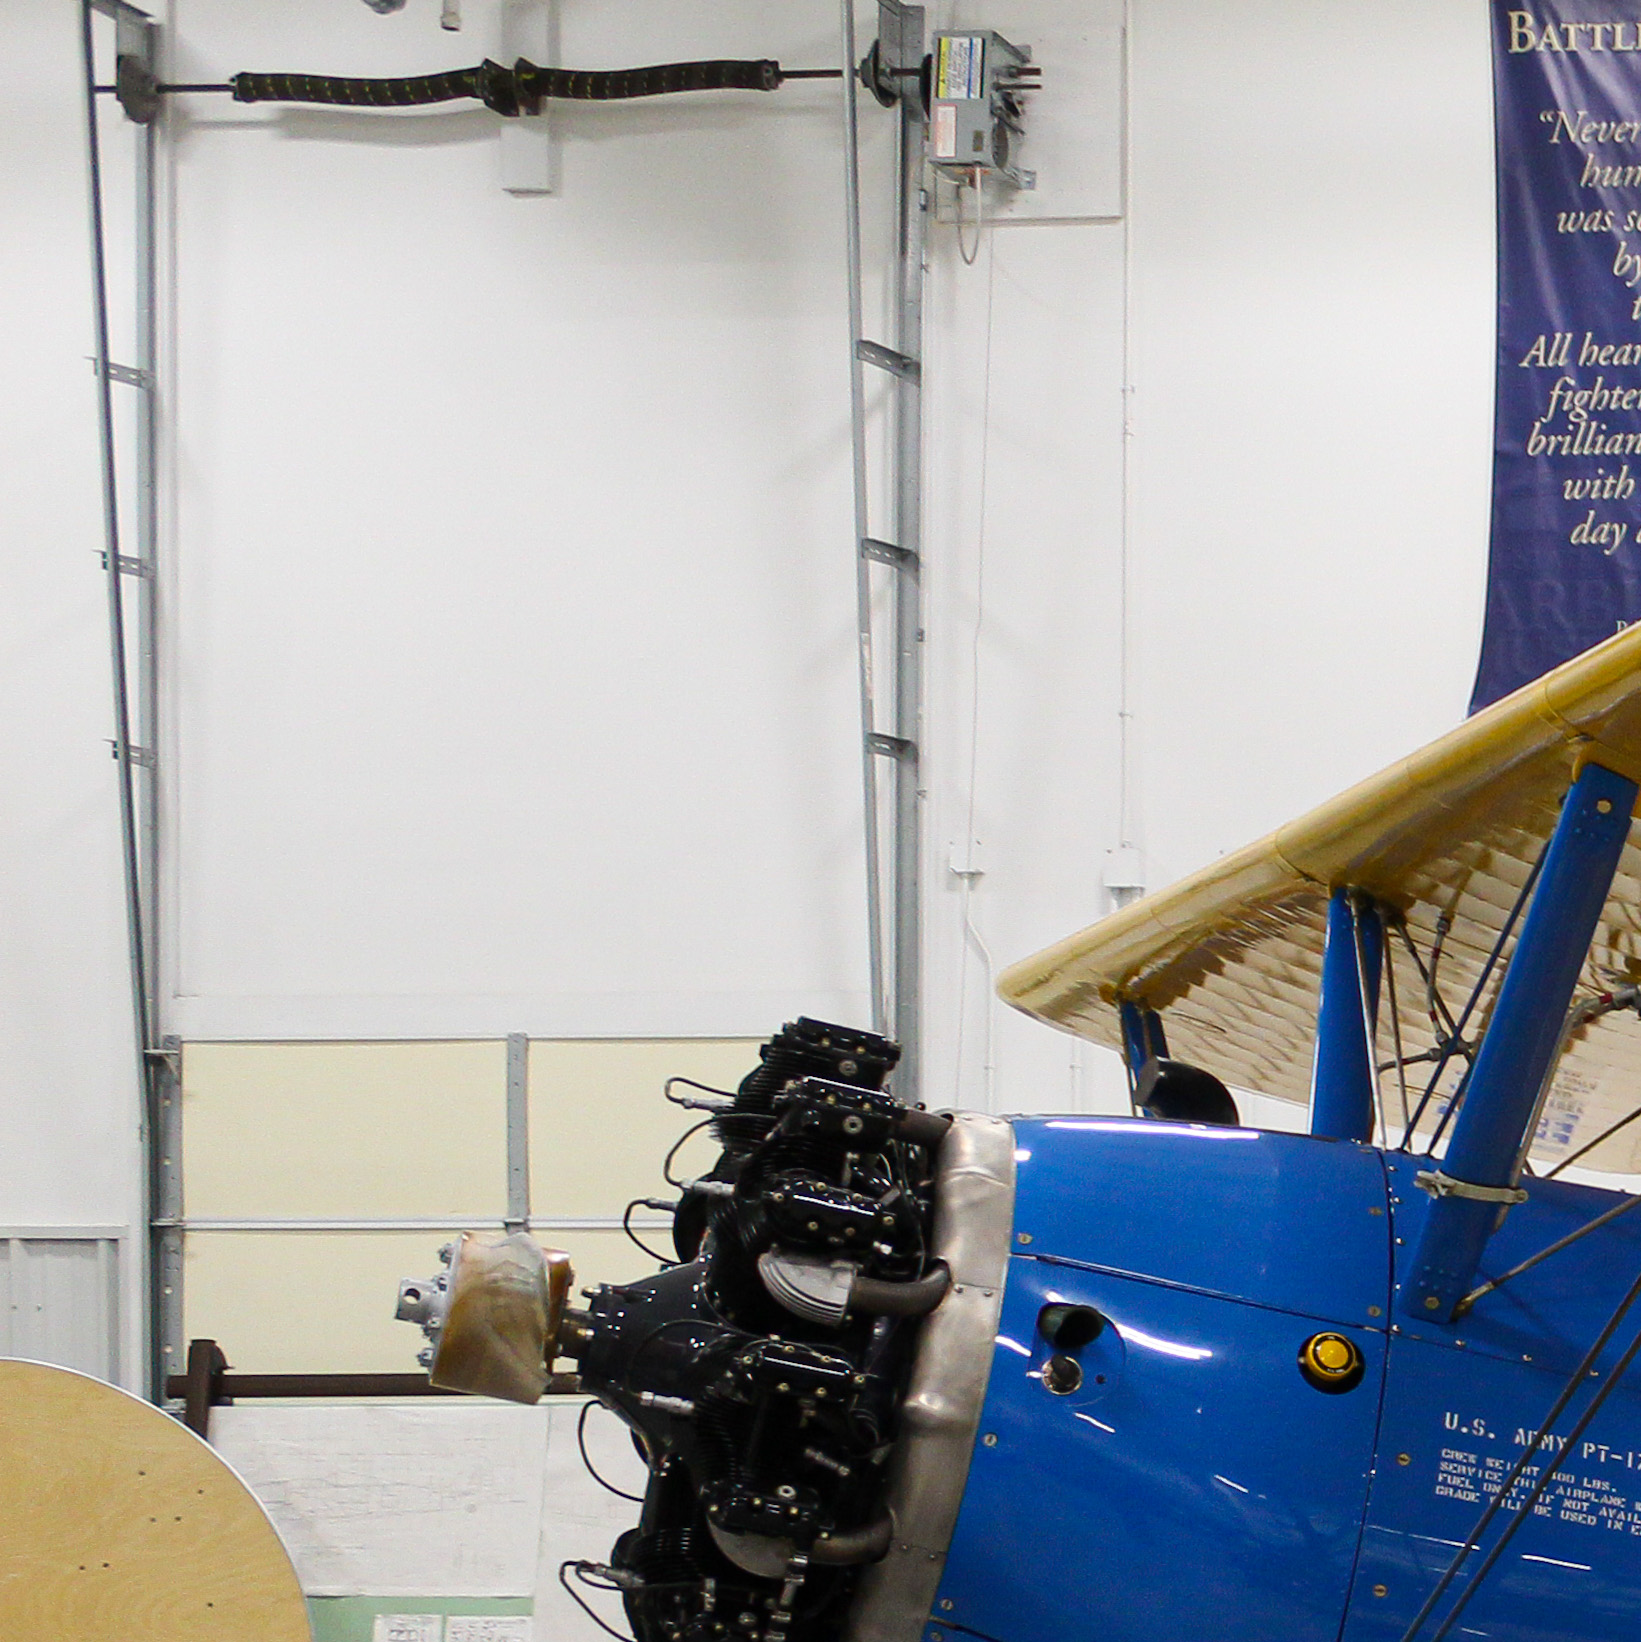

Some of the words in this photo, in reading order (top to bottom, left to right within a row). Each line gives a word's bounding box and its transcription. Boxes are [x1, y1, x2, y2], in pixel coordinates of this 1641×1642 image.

[1558, 210, 1614, 235] was
[1519, 332, 1572, 367] All
[1564, 465, 1635, 499] with
[1571, 510, 1626, 555] day
[1445, 1412, 1496, 1439] U.S.
[1438, 1473, 1474, 1489] FUEL
[1440, 1462, 1503, 1482] SERVICE
[1556, 1485, 1626, 1508] AIRPLANE
[1583, 1477, 1617, 1493] LBS.
[1435, 1486, 1480, 1503] GRADE
[1560, 1509, 1597, 1525] USED
